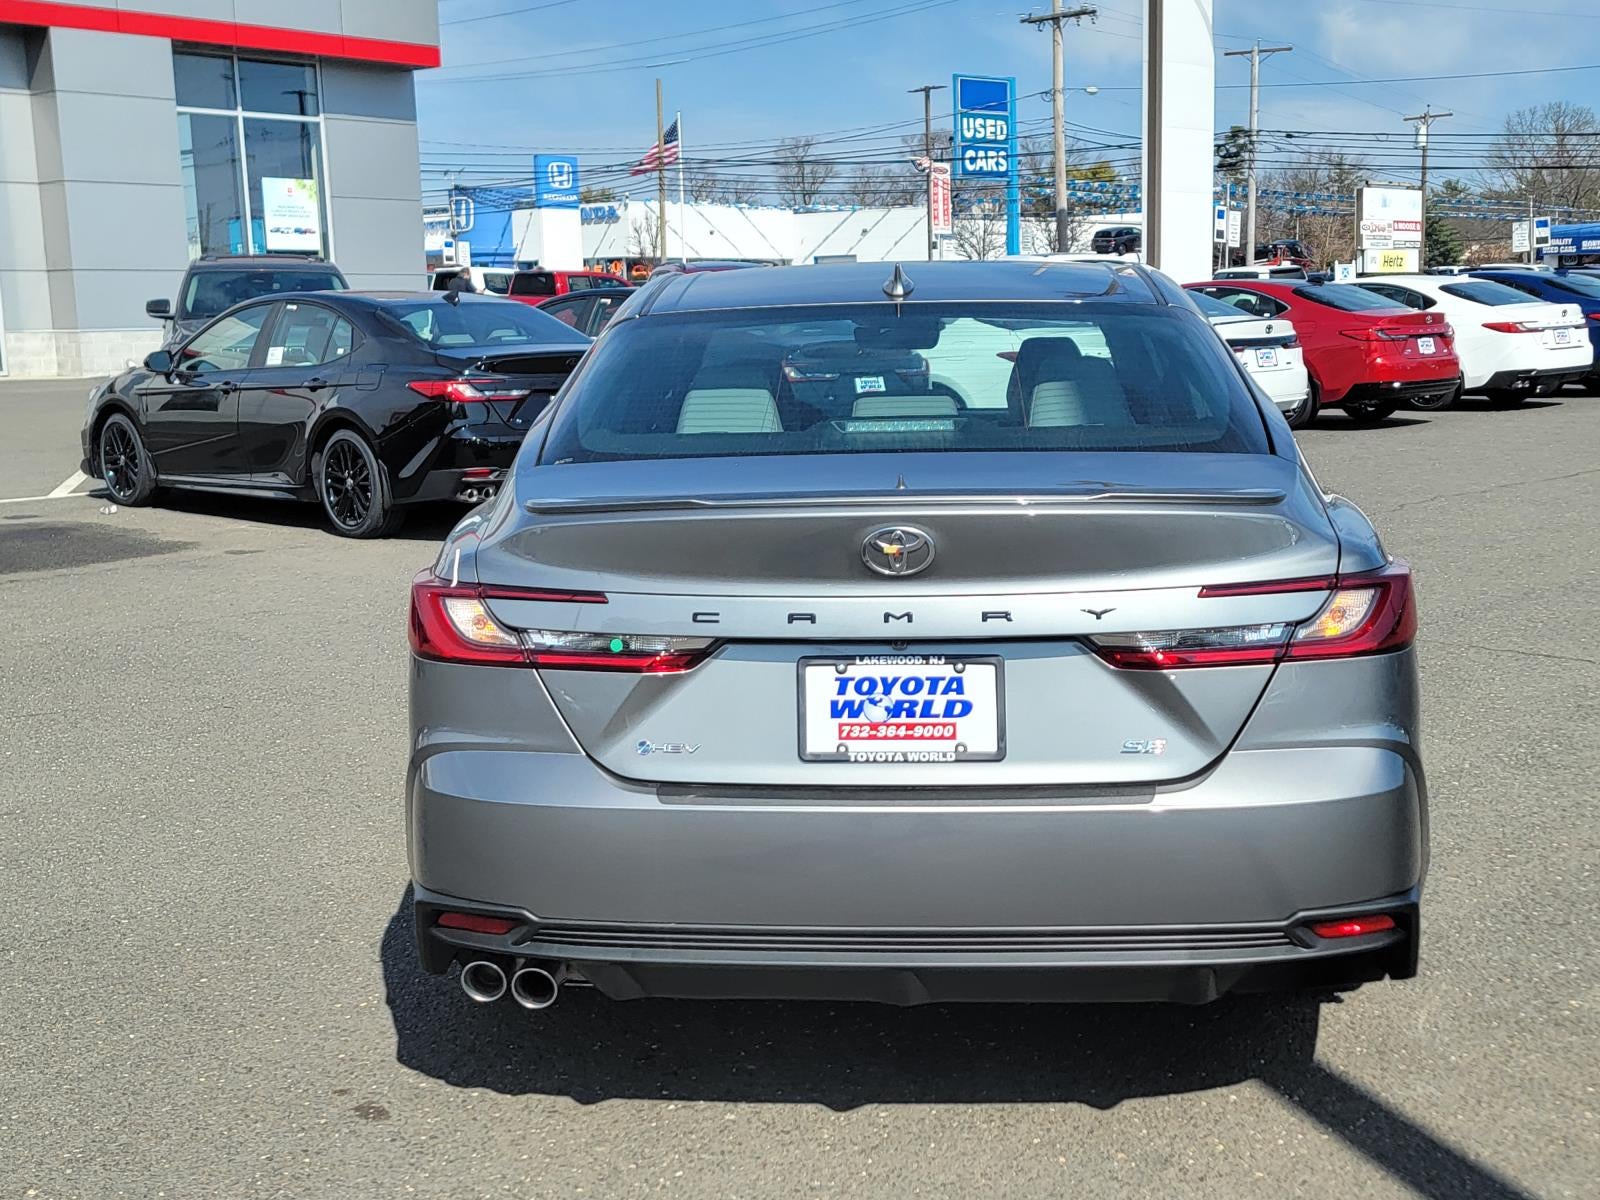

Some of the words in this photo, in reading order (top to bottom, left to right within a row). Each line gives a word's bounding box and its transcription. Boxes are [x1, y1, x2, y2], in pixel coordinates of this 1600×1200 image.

[963, 118, 1007, 140] USED
[965, 150, 1007, 172] CARS
[543, 193, 578, 201] HONDA
[1551, 238, 1573, 246] UALITY
[1382, 255, 1404, 267] Hertz
[692, 607, 1117, 624] CAMRY
[929, 656, 945, 665] NJ
[834, 676, 965, 696] TOYOTA
[841, 725, 953, 738] 732-364-9000
[652, 743, 702, 754] HEV
[847, 752, 905, 762] TOYOTA
[907, 752, 956, 762] WORLD
